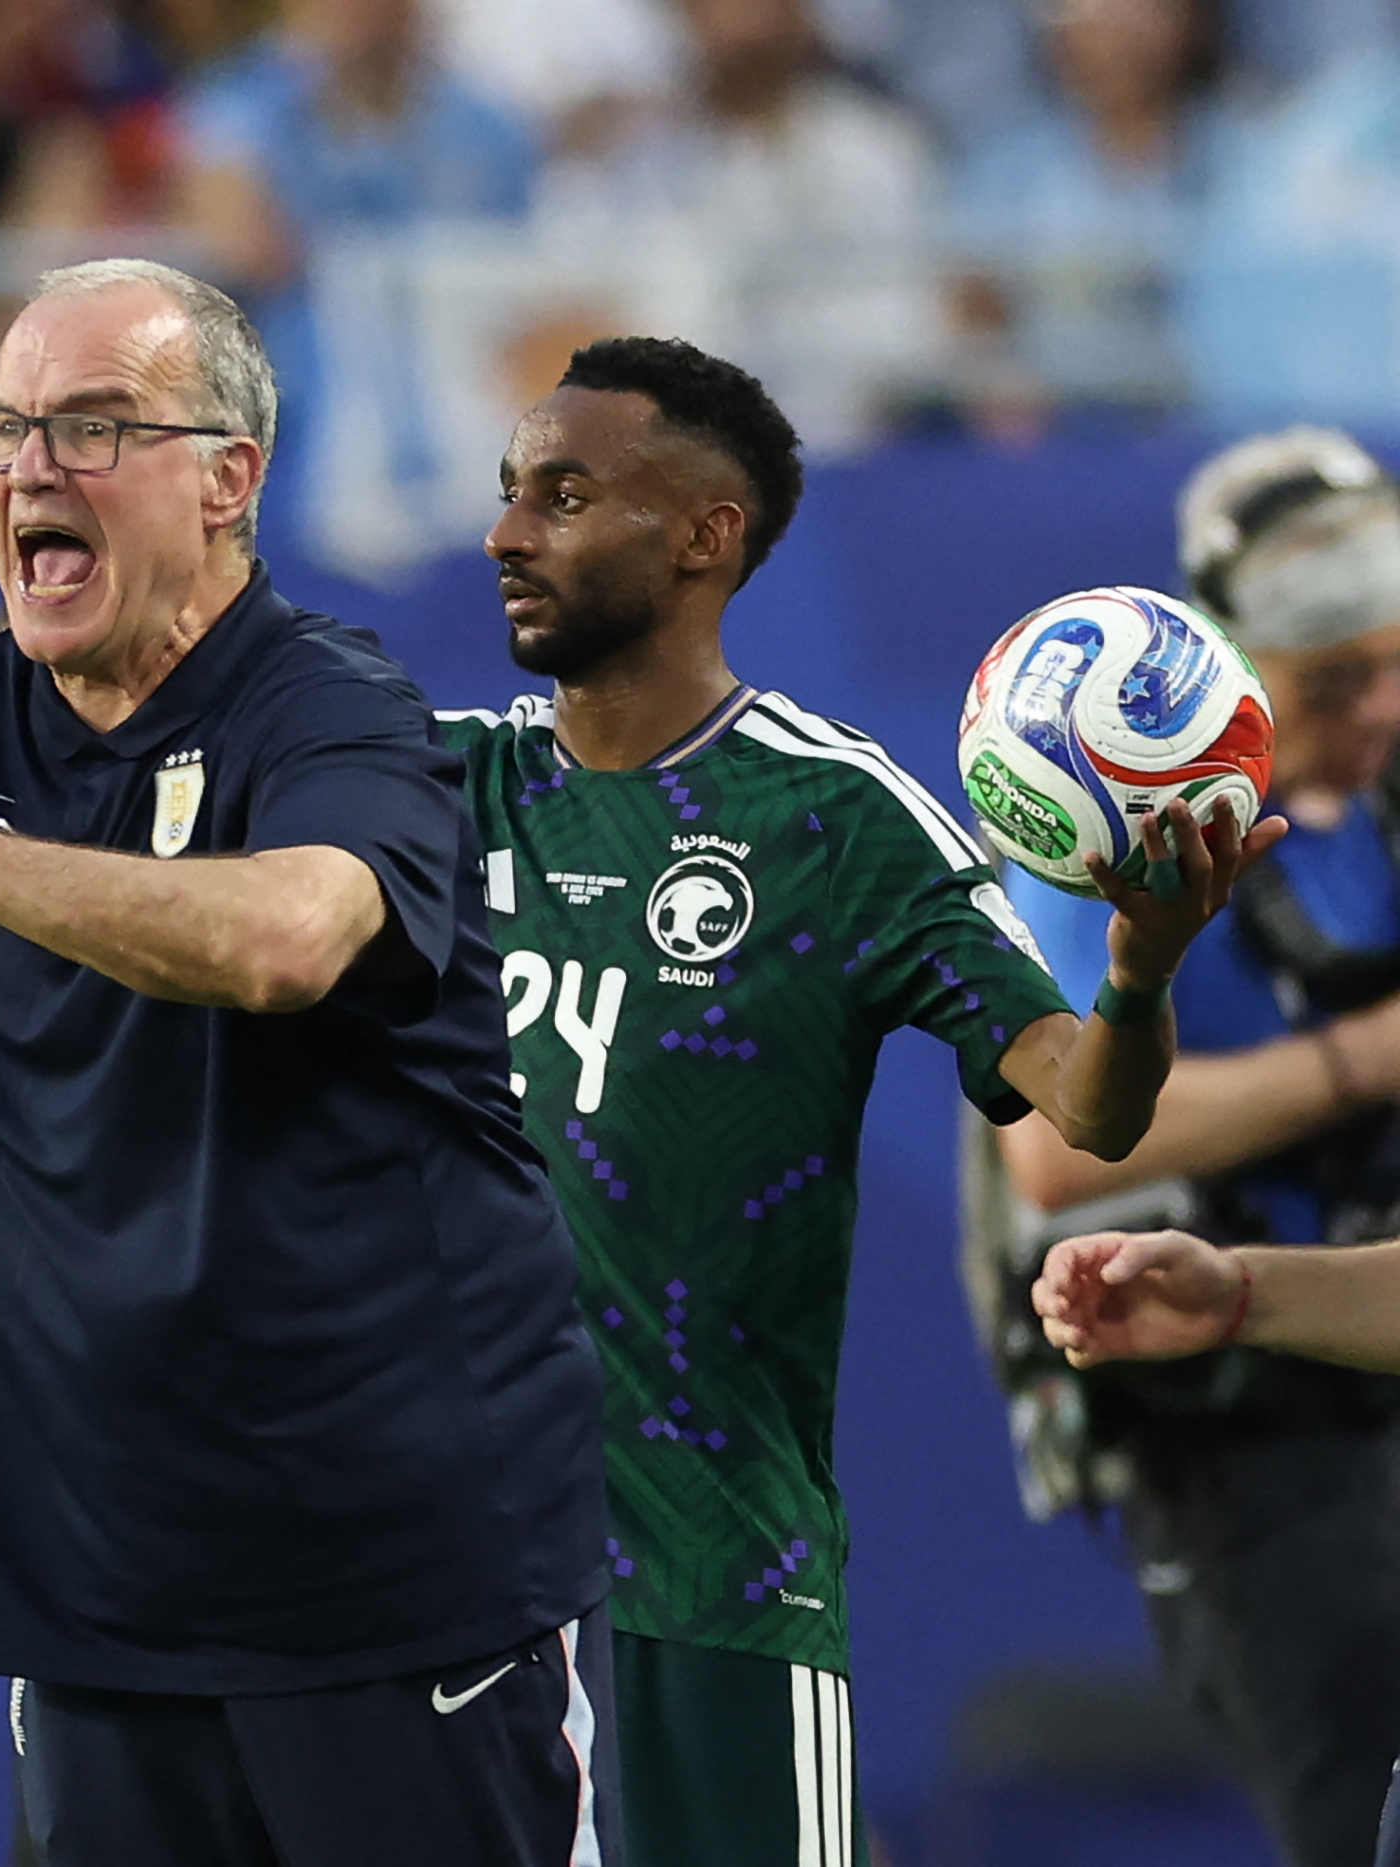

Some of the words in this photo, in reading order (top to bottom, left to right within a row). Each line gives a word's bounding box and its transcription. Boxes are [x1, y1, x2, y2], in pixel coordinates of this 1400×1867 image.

[986, 762, 1058, 827] TRIONDA
[670, 834, 751, 861] السعودية
[699, 921, 729, 933] SAFF
[658, 965, 715, 988] SAUDI
